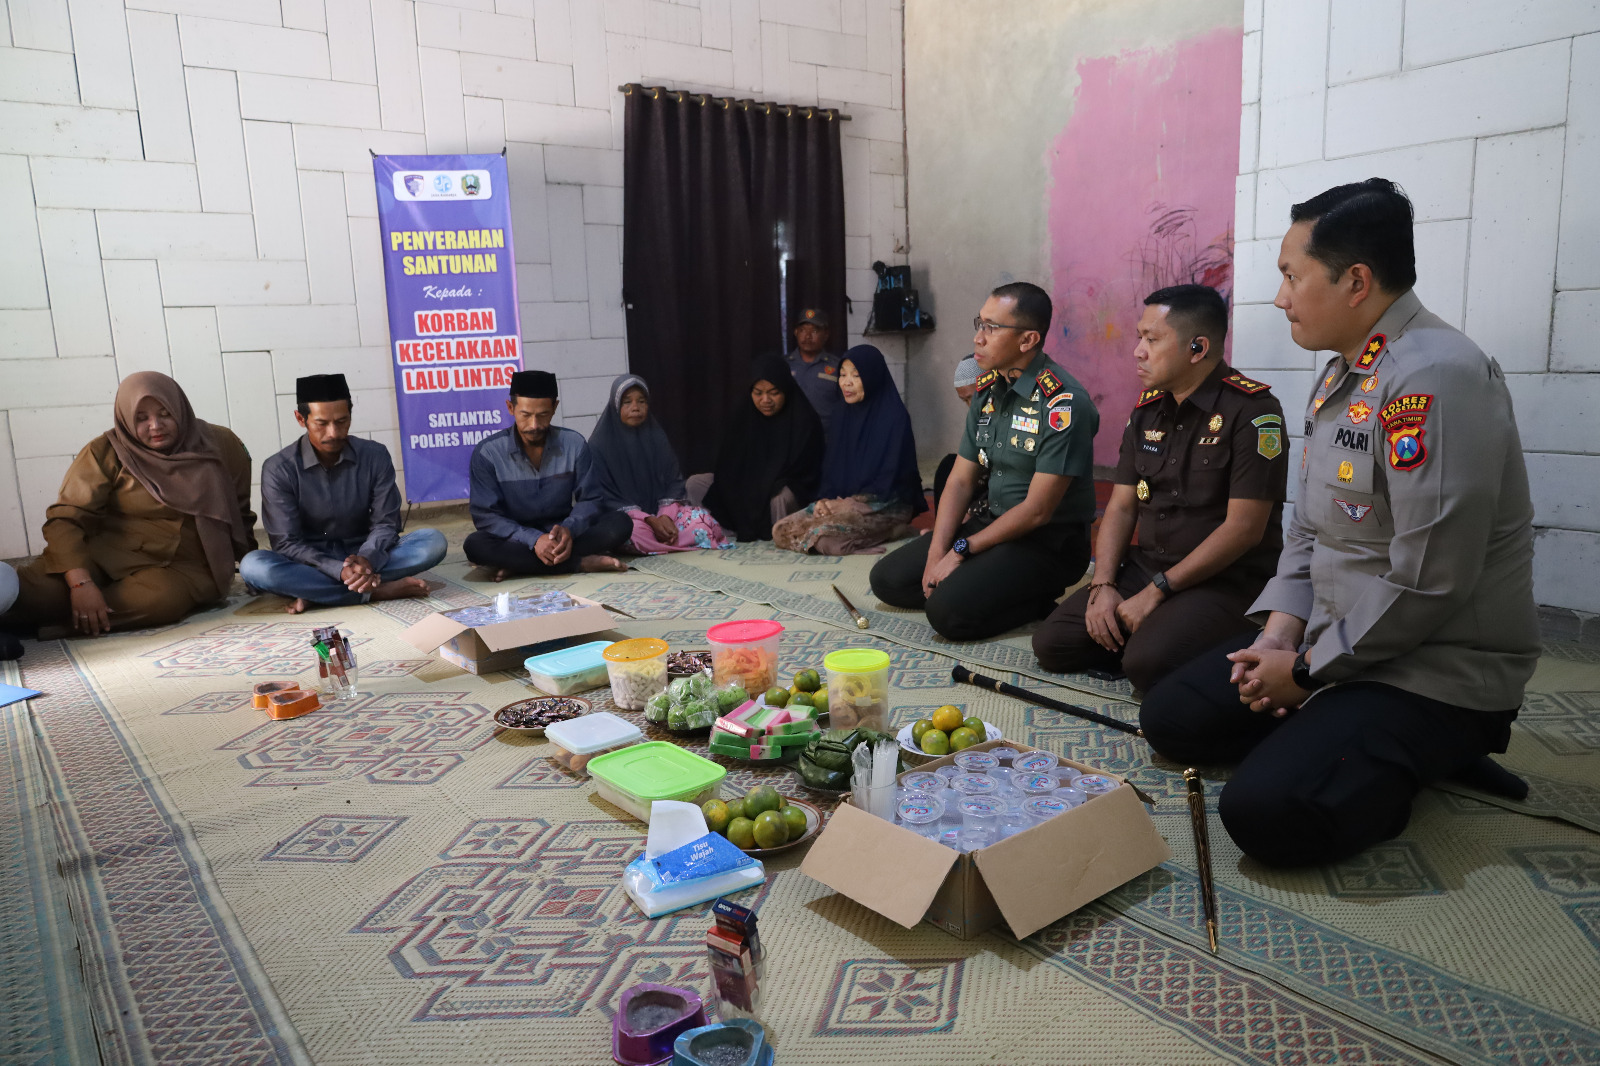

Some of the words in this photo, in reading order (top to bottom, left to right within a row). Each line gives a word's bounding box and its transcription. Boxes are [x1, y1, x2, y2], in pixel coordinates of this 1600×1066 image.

[391, 229, 504, 251] PENYERAHAN
[403, 254, 497, 275] SANTUNAN
[423, 285, 472, 301] Kepada
[417, 311, 494, 333] KORBAN
[399, 338, 517, 363] KECELAKAAN
[405, 369, 450, 391] LALU
[454, 366, 515, 388] LINTAS
[1381, 396, 1427, 418] POLRES
[1385, 403, 1425, 421] MAGETAN
[429, 410, 502, 428] SATLANTAS
[1387, 419, 1402, 430] JAWA
[410, 431, 460, 449] POLRES
[1335, 428, 1368, 451] POLRI
[1028, 759, 1049, 769] Club
[1081, 777, 1102, 785] Club
[905, 807, 929, 816] Club
[1036, 800, 1061, 808] Club
[690, 847, 714, 862] Wajah
[693, 841, 708, 853] Tisu
